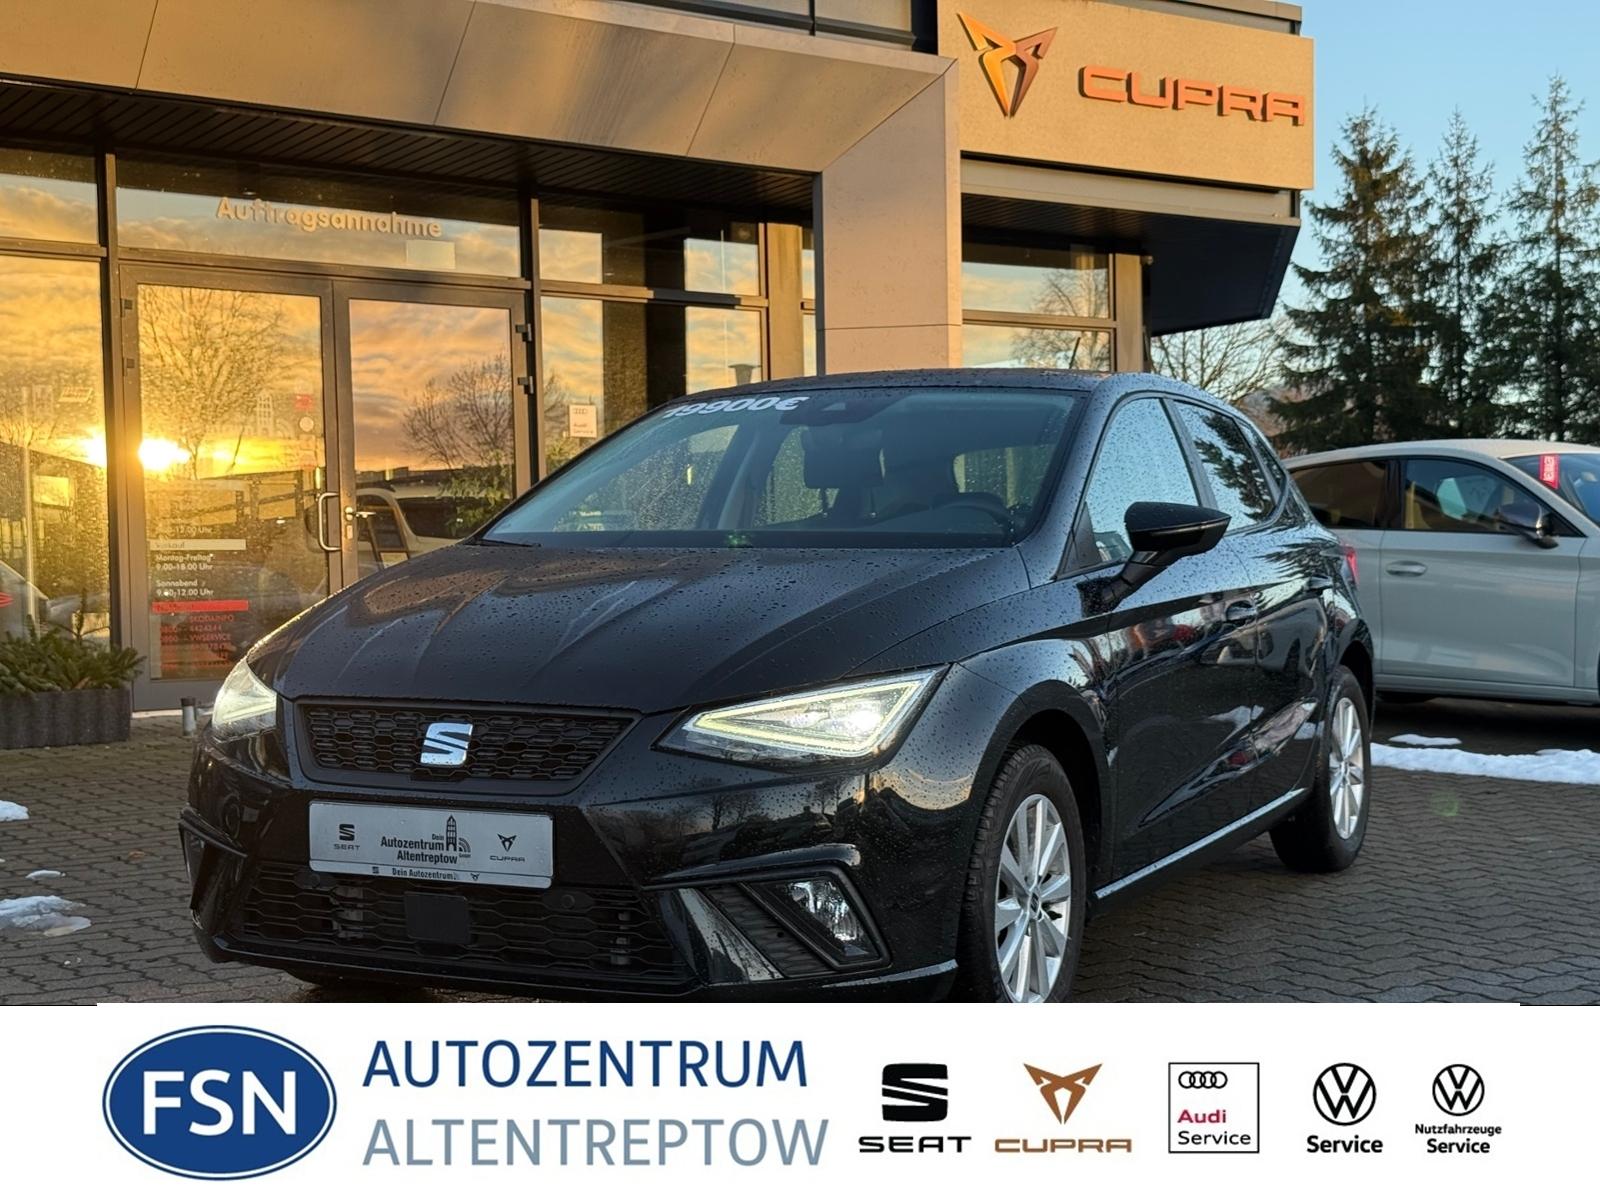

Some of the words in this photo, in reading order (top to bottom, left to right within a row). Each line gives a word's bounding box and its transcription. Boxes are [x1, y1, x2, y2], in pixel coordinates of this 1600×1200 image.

[1078, 65, 1305, 126] CUPRA
[216, 197, 442, 237] Auftragsannahme
[156, 553, 211, 563] Montag-Freitag
[199, 562, 213, 570] Uhr
[156, 579, 198, 587] Sonnabend
[200, 588, 214, 596] Uhr
[431, 833, 445, 841] Dein
[333, 843, 361, 851] SEAT
[380, 836, 445, 852] Autozentrum
[396, 850, 458, 865] Altentreptow
[489, 855, 526, 863] CUPRA
[392, 867, 408, 876] Dein
